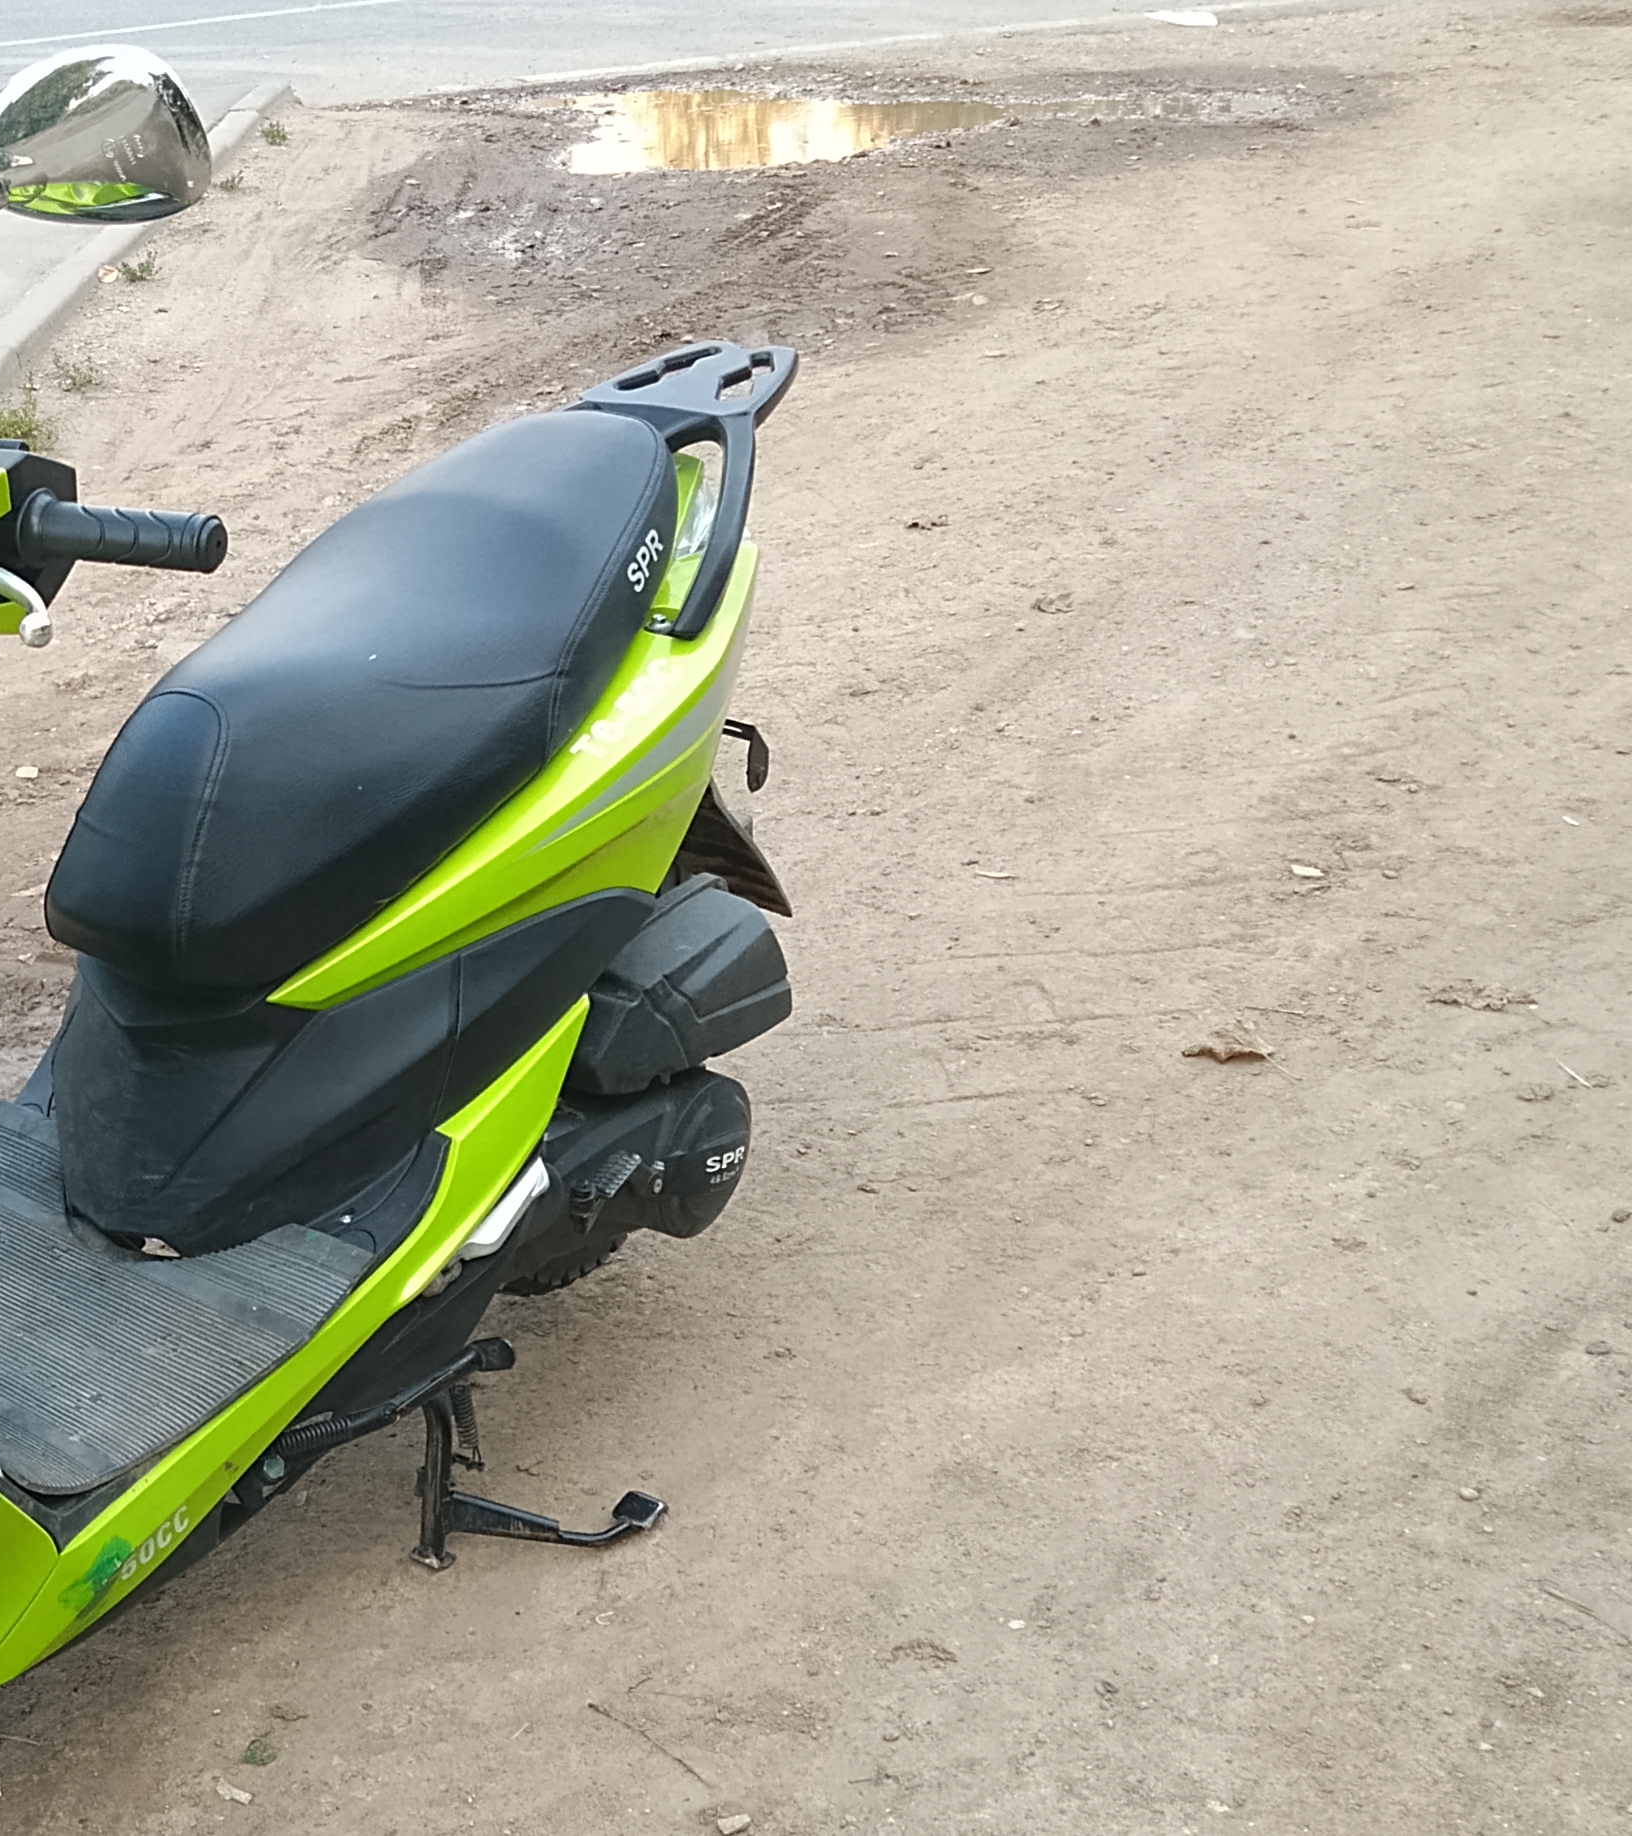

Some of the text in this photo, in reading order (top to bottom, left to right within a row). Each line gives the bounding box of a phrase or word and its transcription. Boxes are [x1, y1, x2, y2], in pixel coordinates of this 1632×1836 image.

[626, 528, 664, 593] SPR
[705, 1145, 745, 1173] SPR
[120, 1505, 189, 1580] 50CC
